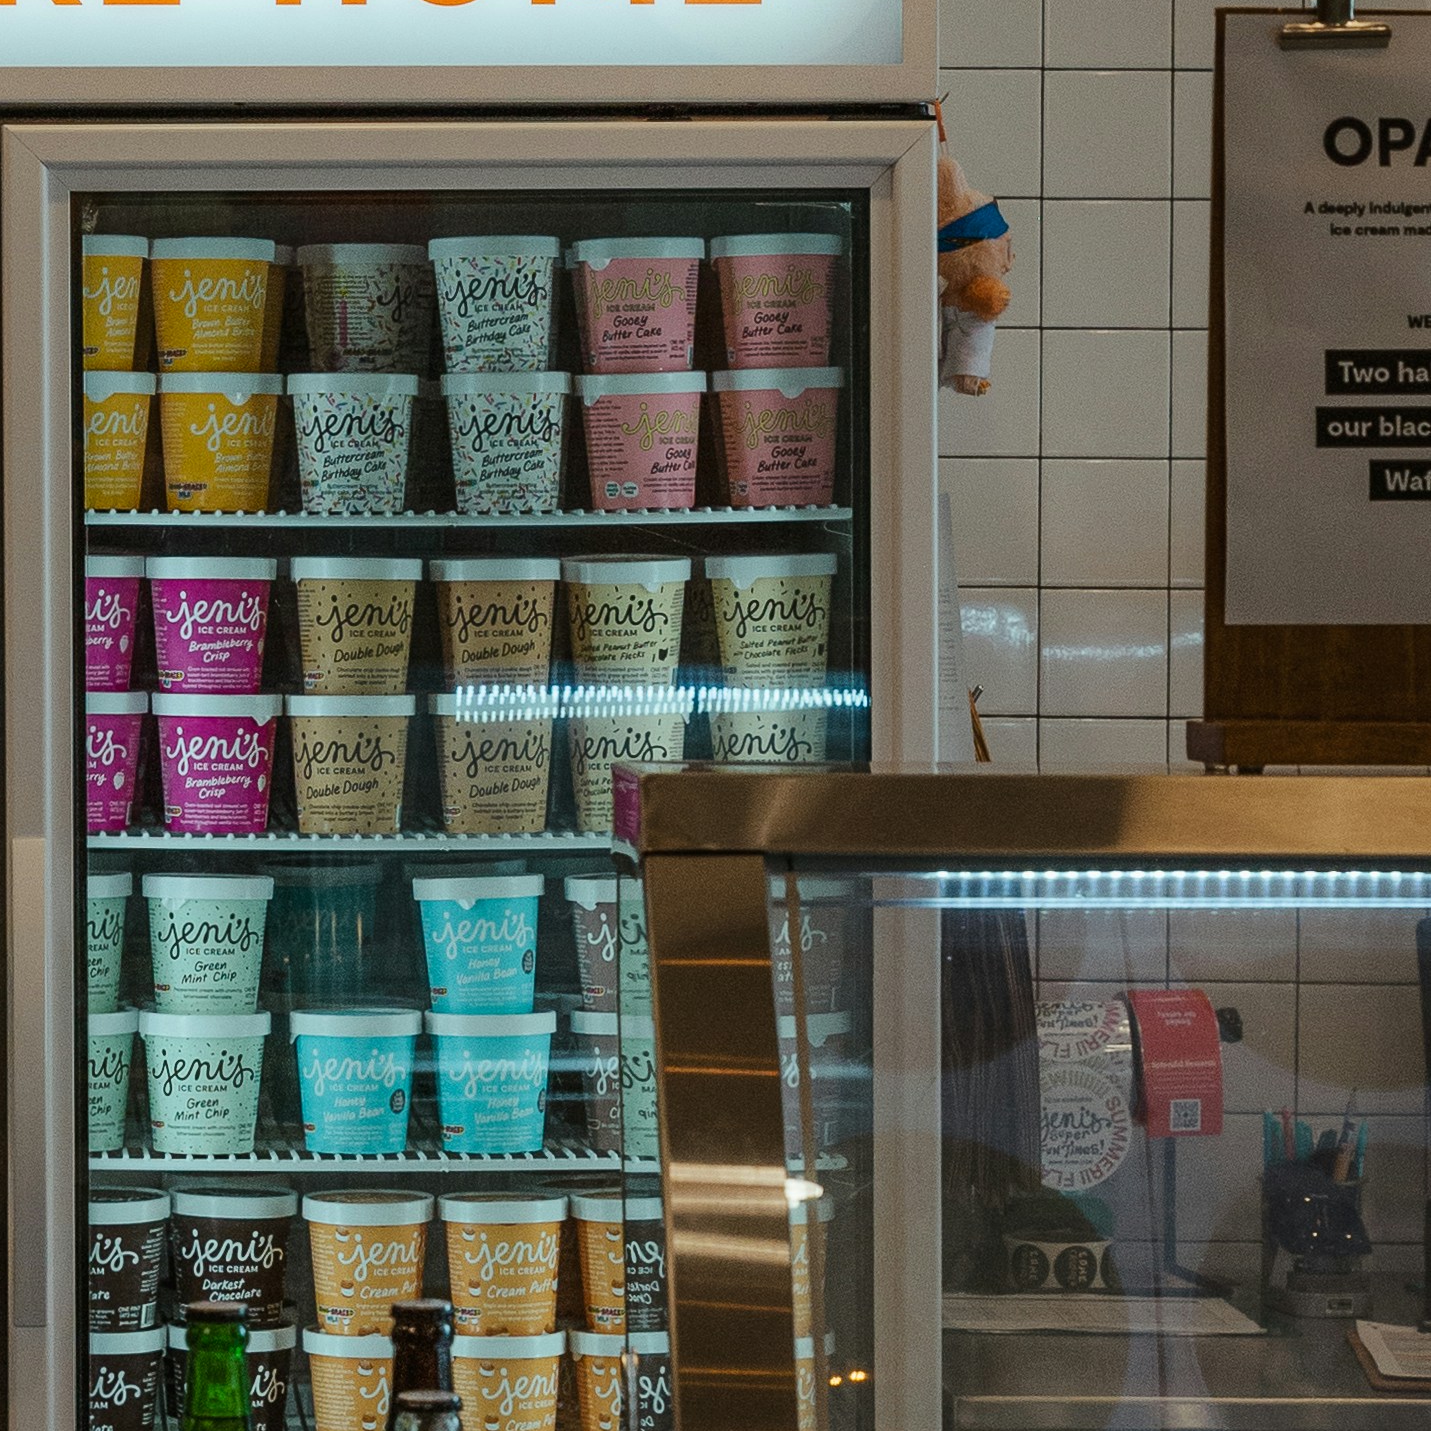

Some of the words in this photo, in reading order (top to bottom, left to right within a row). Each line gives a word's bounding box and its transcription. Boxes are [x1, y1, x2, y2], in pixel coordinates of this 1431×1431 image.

[1304, 202, 1314, 214] A
[1318, 201, 1365, 217] deeply
[1355, 225, 1400, 235] cream
[446, 268, 547, 318] jeni's
[613, 314, 648, 329] Gooey
[602, 327, 632, 342] Butter
[636, 327, 662, 338] Cake
[1338, 361, 1390, 383] Two
[303, 404, 404, 453] jeni's
[459, 403, 559, 452] jeni's
[1328, 421, 1372, 437] our
[323, 449, 385, 468] Buttercream
[321, 466, 363, 482] Birthday
[364, 459, 387, 474] Cake
[167, 590, 267, 640] jeni's
[317, 595, 412, 643] jeni's
[447, 594, 547, 643] jeni's
[570, 594, 668, 642] jeni's
[723, 590, 826, 638] jeni's
[216, 626, 246, 635] CREAM
[189, 638, 253, 655] Brambleberry
[740, 641, 764, 649] Salted
[768, 637, 795, 647] Peanut
[203, 650, 230, 663] Crisp
[165, 726, 269, 776] jeni's
[295, 731, 395, 779] jeni's
[451, 729, 548, 778] jeni's
[571, 727, 667, 771] jeni's
[212, 763, 243, 771] CREAM
[306, 783, 340, 800] Double
[342, 777, 379, 796] Dough
[158, 912, 259, 960] jeni's
[432, 909, 534, 959] jeni's
[194, 961, 227, 972] Green
[468, 956, 501, 970] Honey
[182, 974, 207, 984] Mint
[213, 971, 237, 984] Chip
[456, 970, 491, 985] Vanilla
[493, 967, 518, 980] Bean
[152, 1048, 254, 1096] jeni's
[303, 1048, 406, 1096] jeni's
[448, 1049, 545, 1097] jeni's
[182, 1228, 283, 1277] jeni's
[465, 1231, 557, 1281] jeni's
[202, 1279, 245, 1291] Darkest
[209, 1288, 262, 1302] Chocolate
[487, 1285, 527, 1299] Cream
[530, 1279, 552, 1293] Puff
